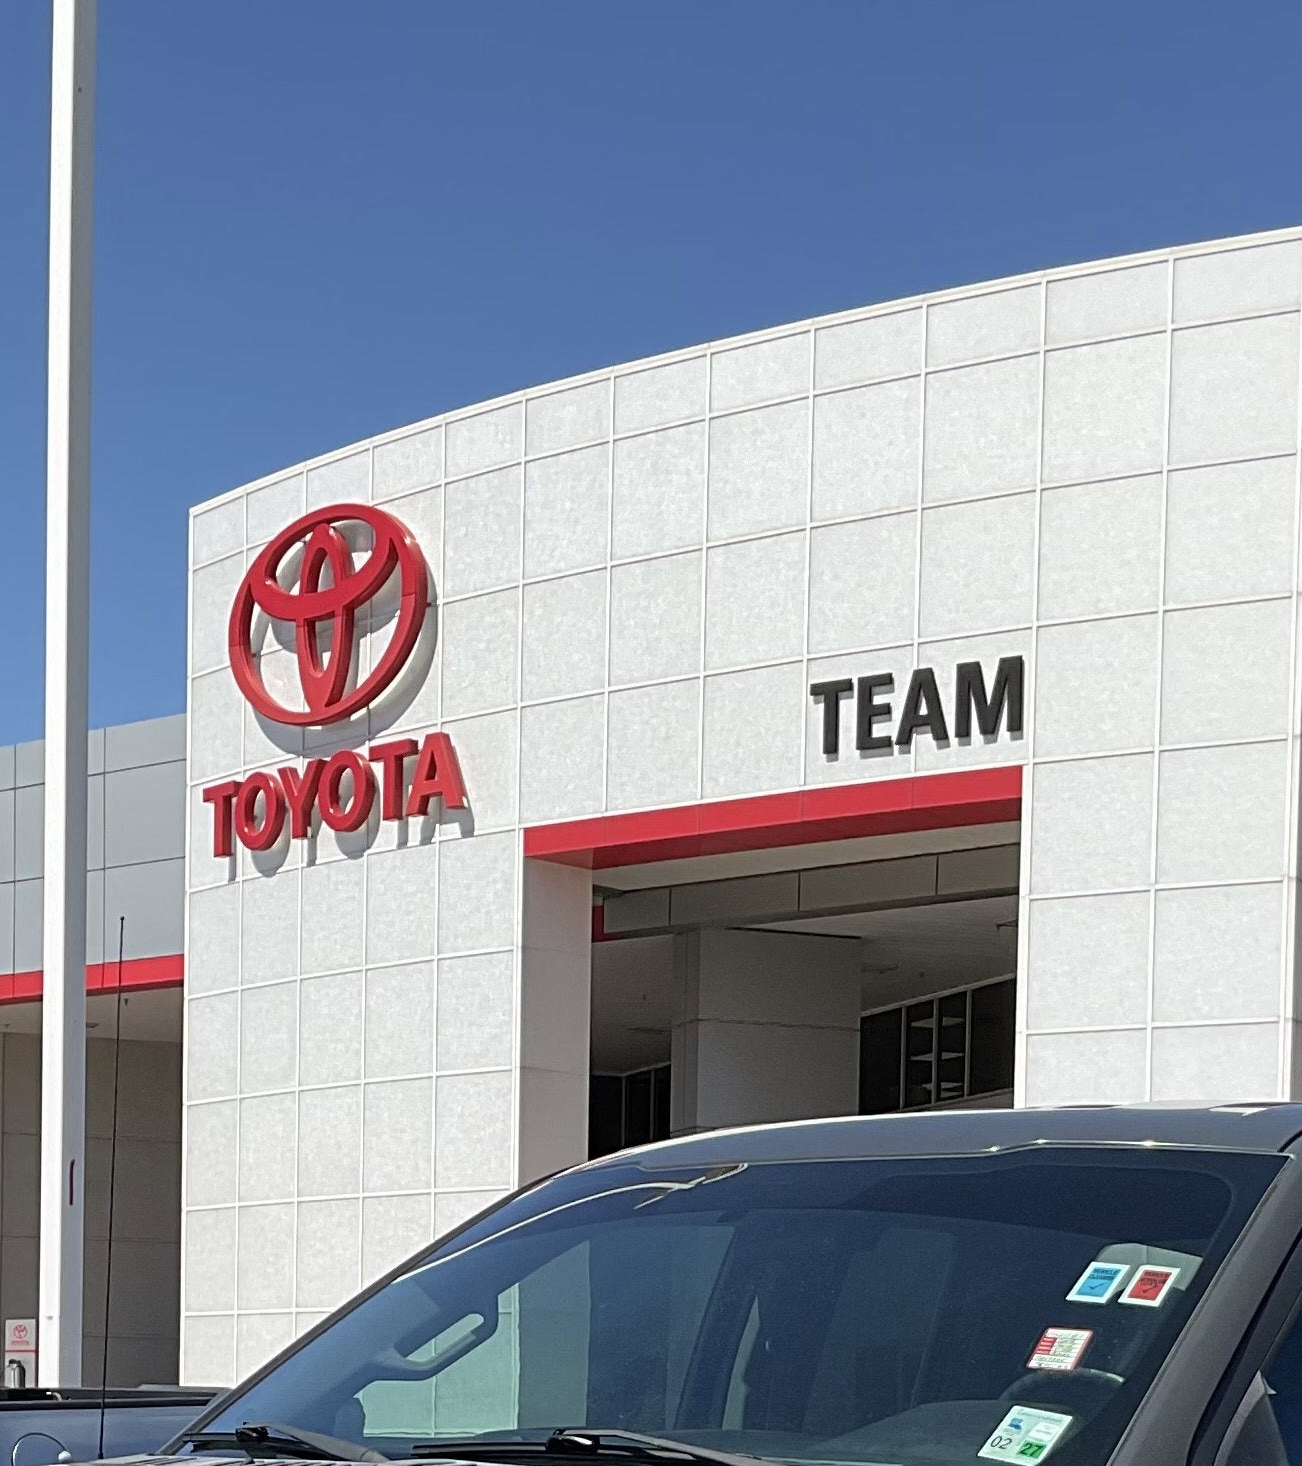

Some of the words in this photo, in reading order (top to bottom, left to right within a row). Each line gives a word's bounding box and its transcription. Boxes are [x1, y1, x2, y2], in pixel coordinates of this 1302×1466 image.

[810, 655, 1026, 756] TEAM
[203, 731, 466, 859] TOYOTA
[990, 1435, 1013, 1450] 02
[1019, 1442, 1043, 1457] 27
